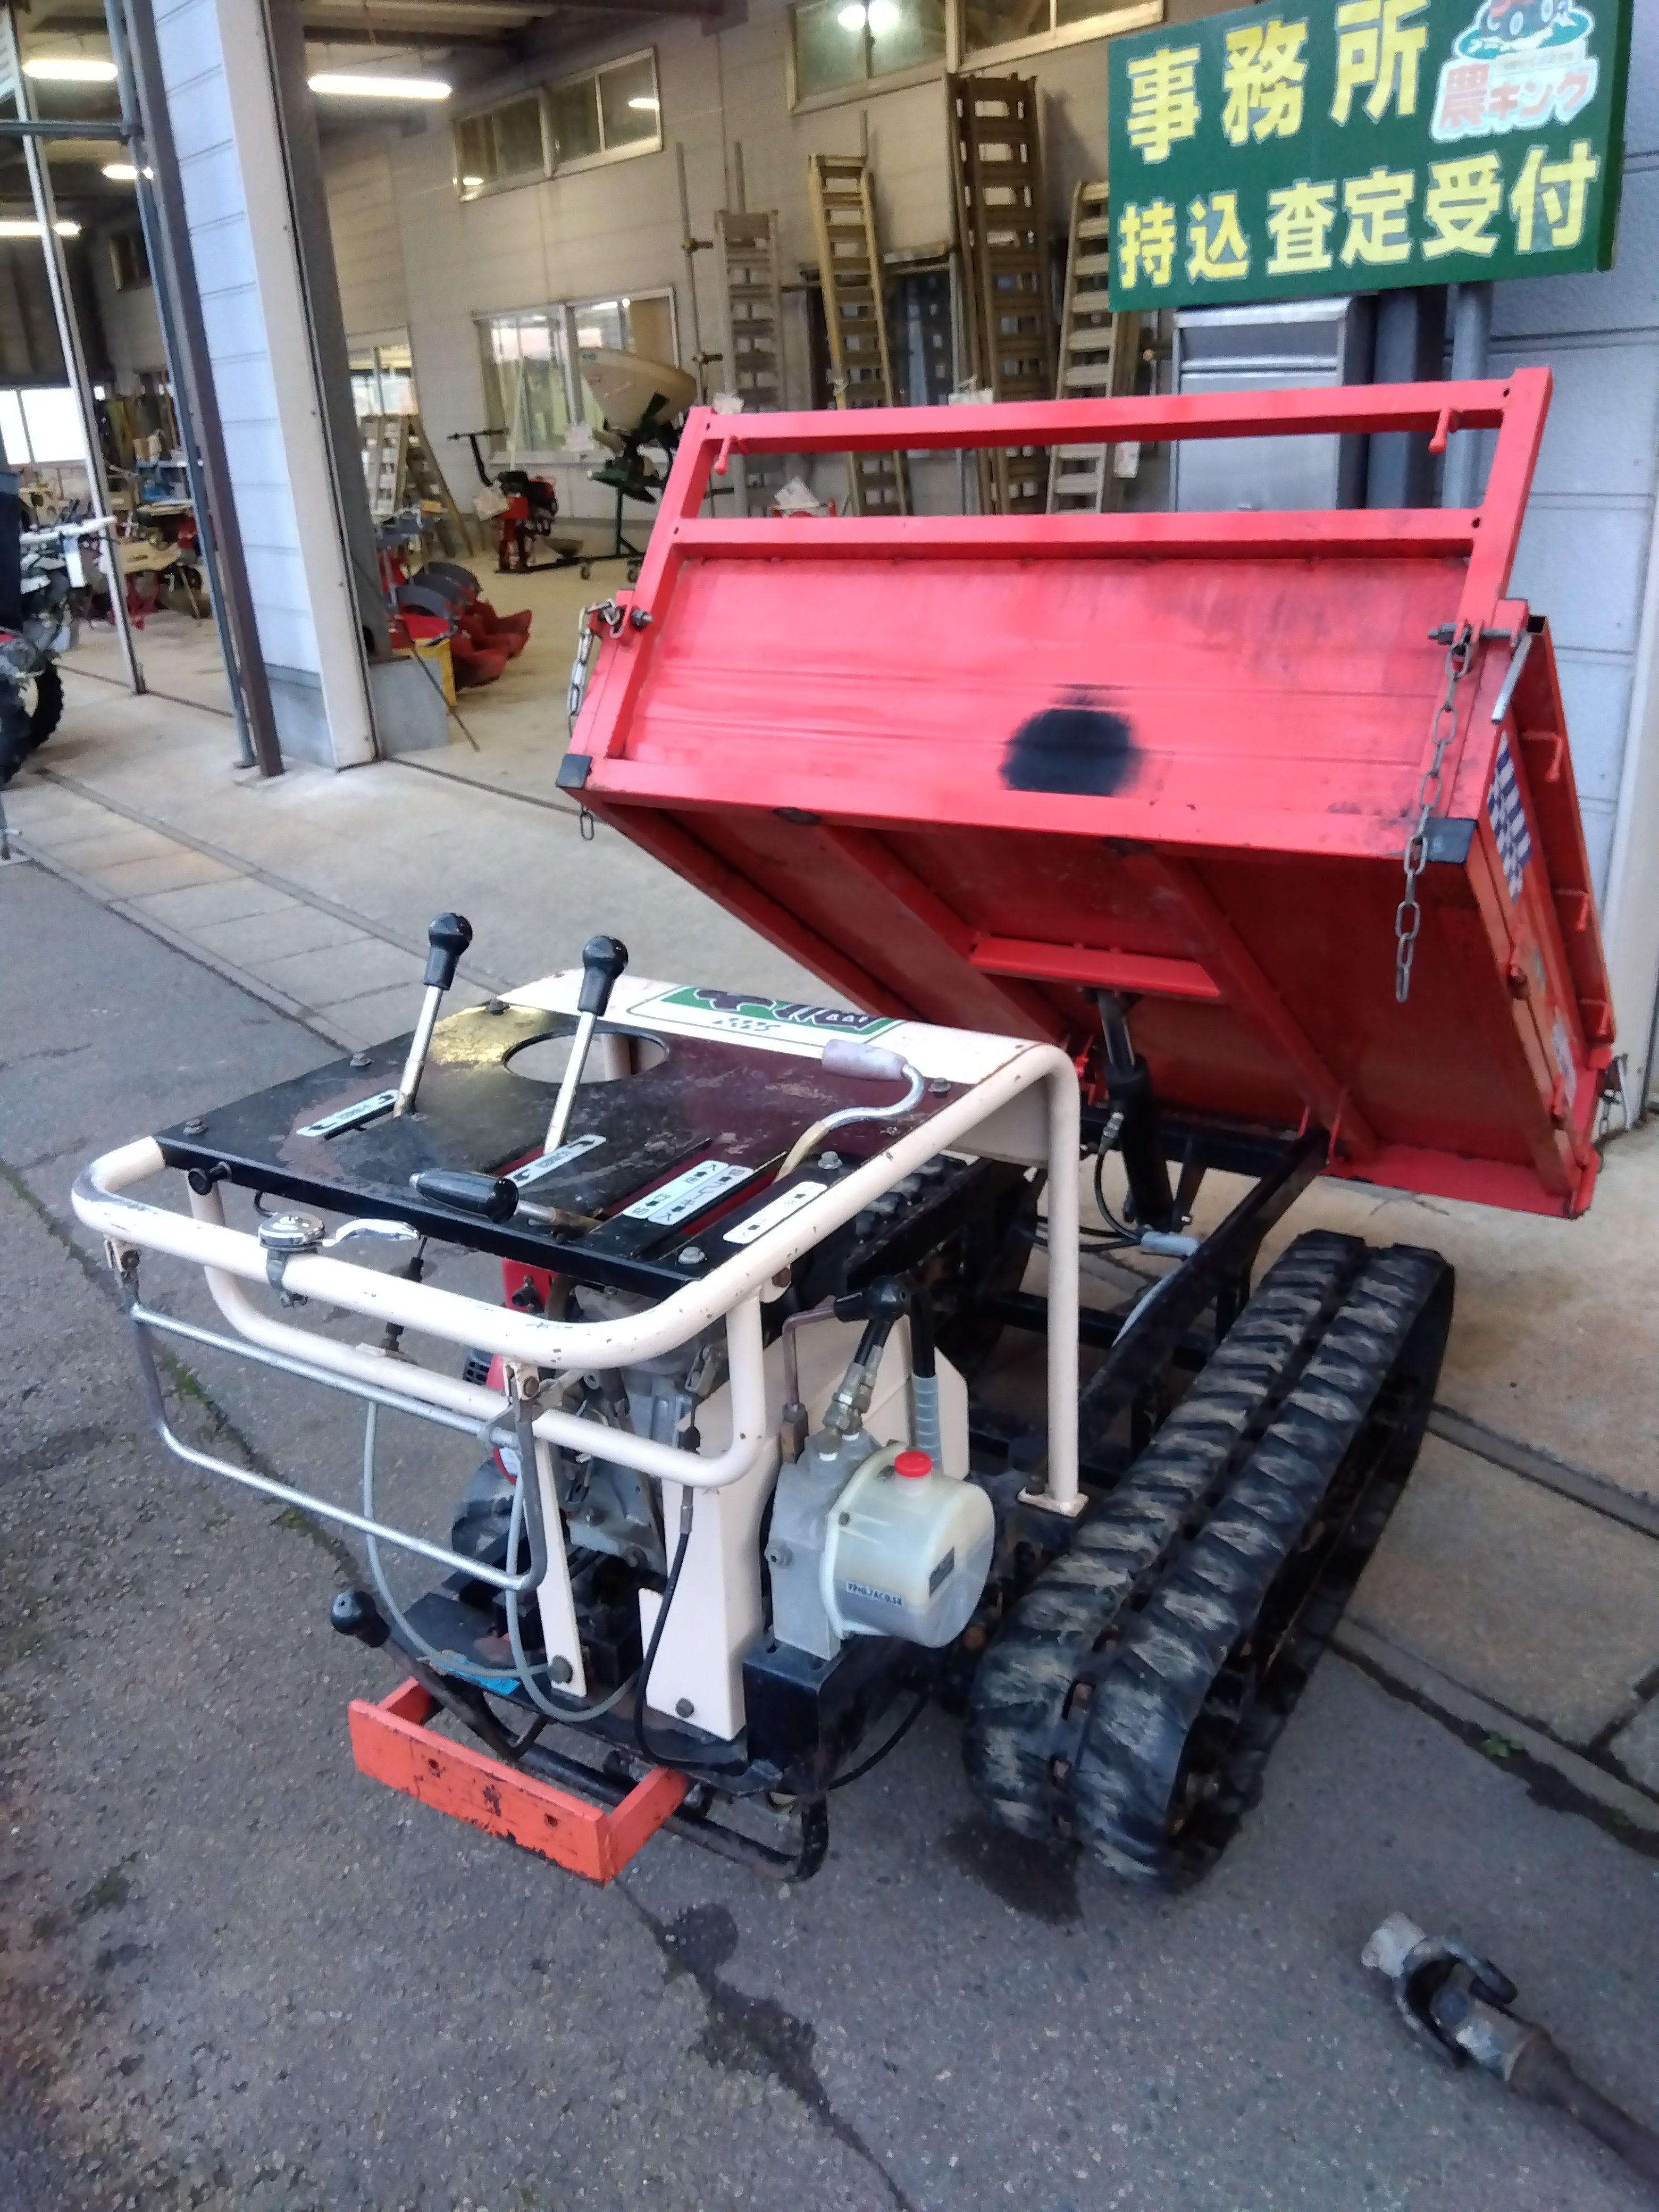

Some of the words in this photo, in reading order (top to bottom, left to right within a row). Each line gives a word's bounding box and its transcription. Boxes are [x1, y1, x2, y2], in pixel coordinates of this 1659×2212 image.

[1126, 0, 1428, 163] 事務所
[1119, 140, 1598, 290] 持込査定受付
